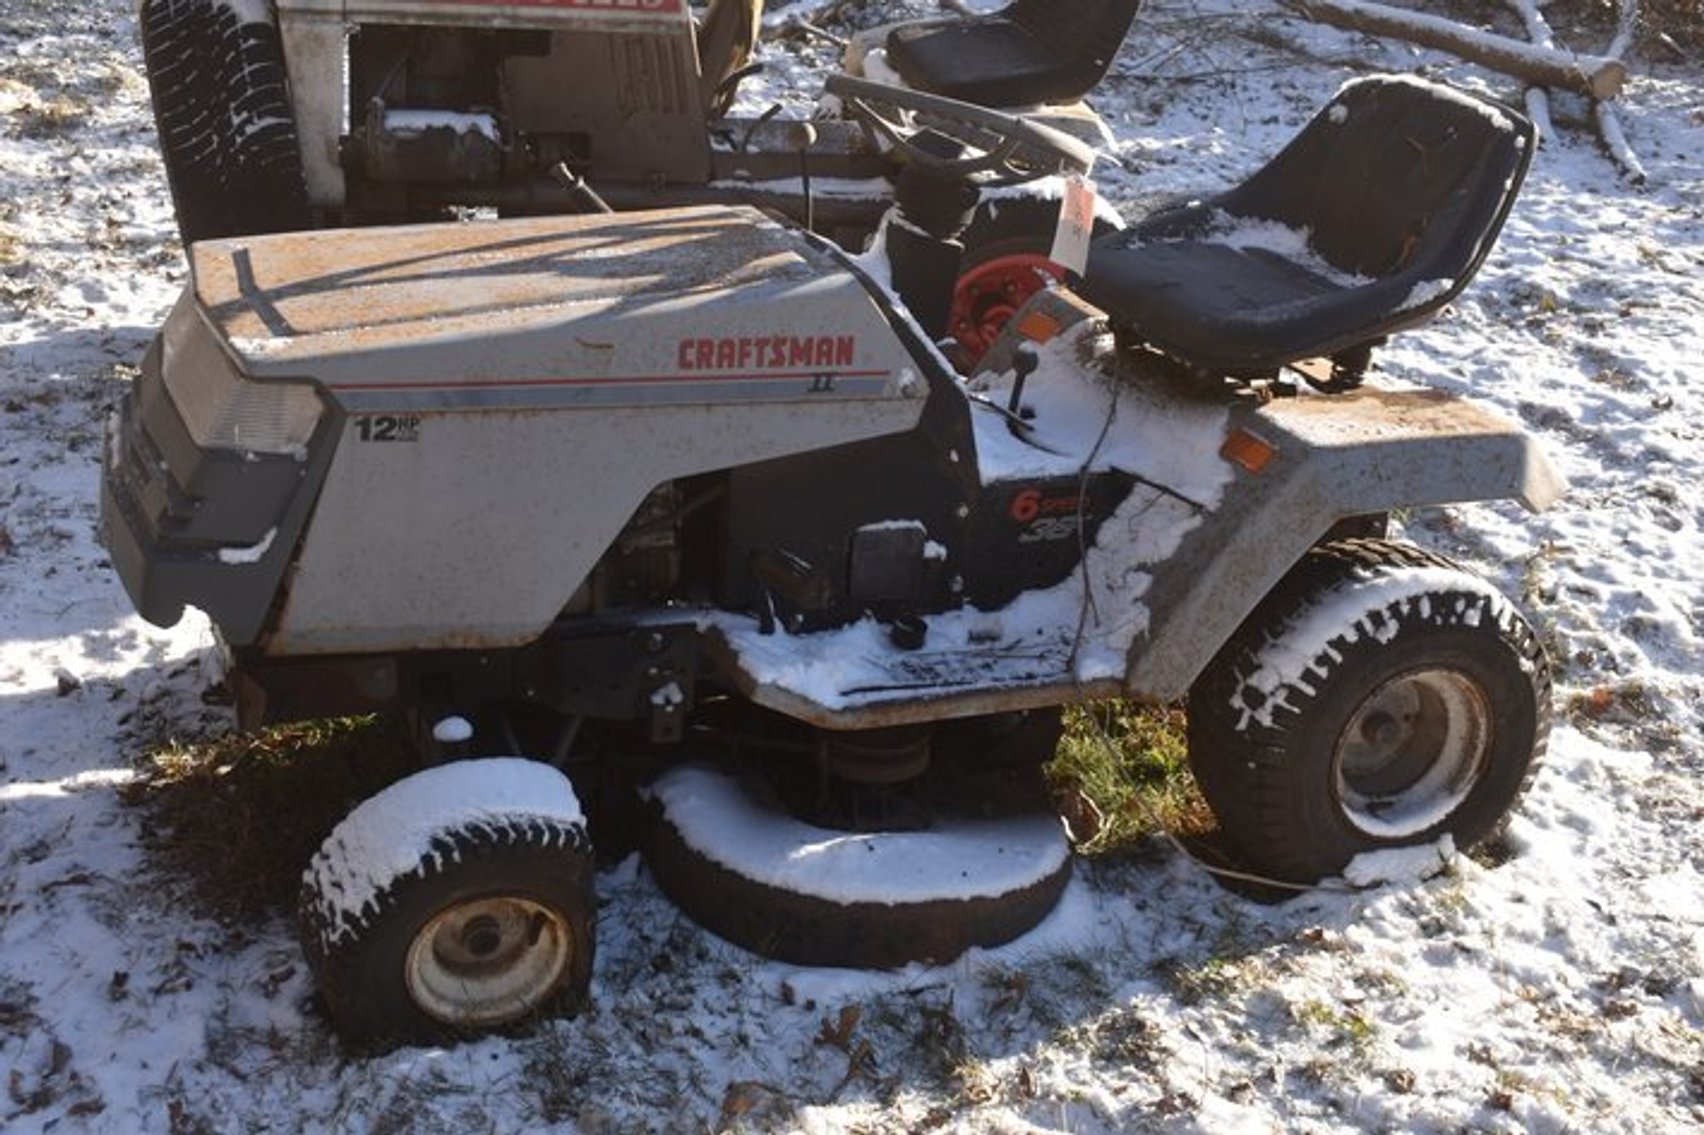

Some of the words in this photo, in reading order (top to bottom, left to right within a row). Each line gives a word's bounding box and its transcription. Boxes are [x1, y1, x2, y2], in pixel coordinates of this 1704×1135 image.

[678, 334, 856, 370] CRAFTSMAN
[355, 416, 398, 443] 12
[1011, 489, 1041, 523] 6
